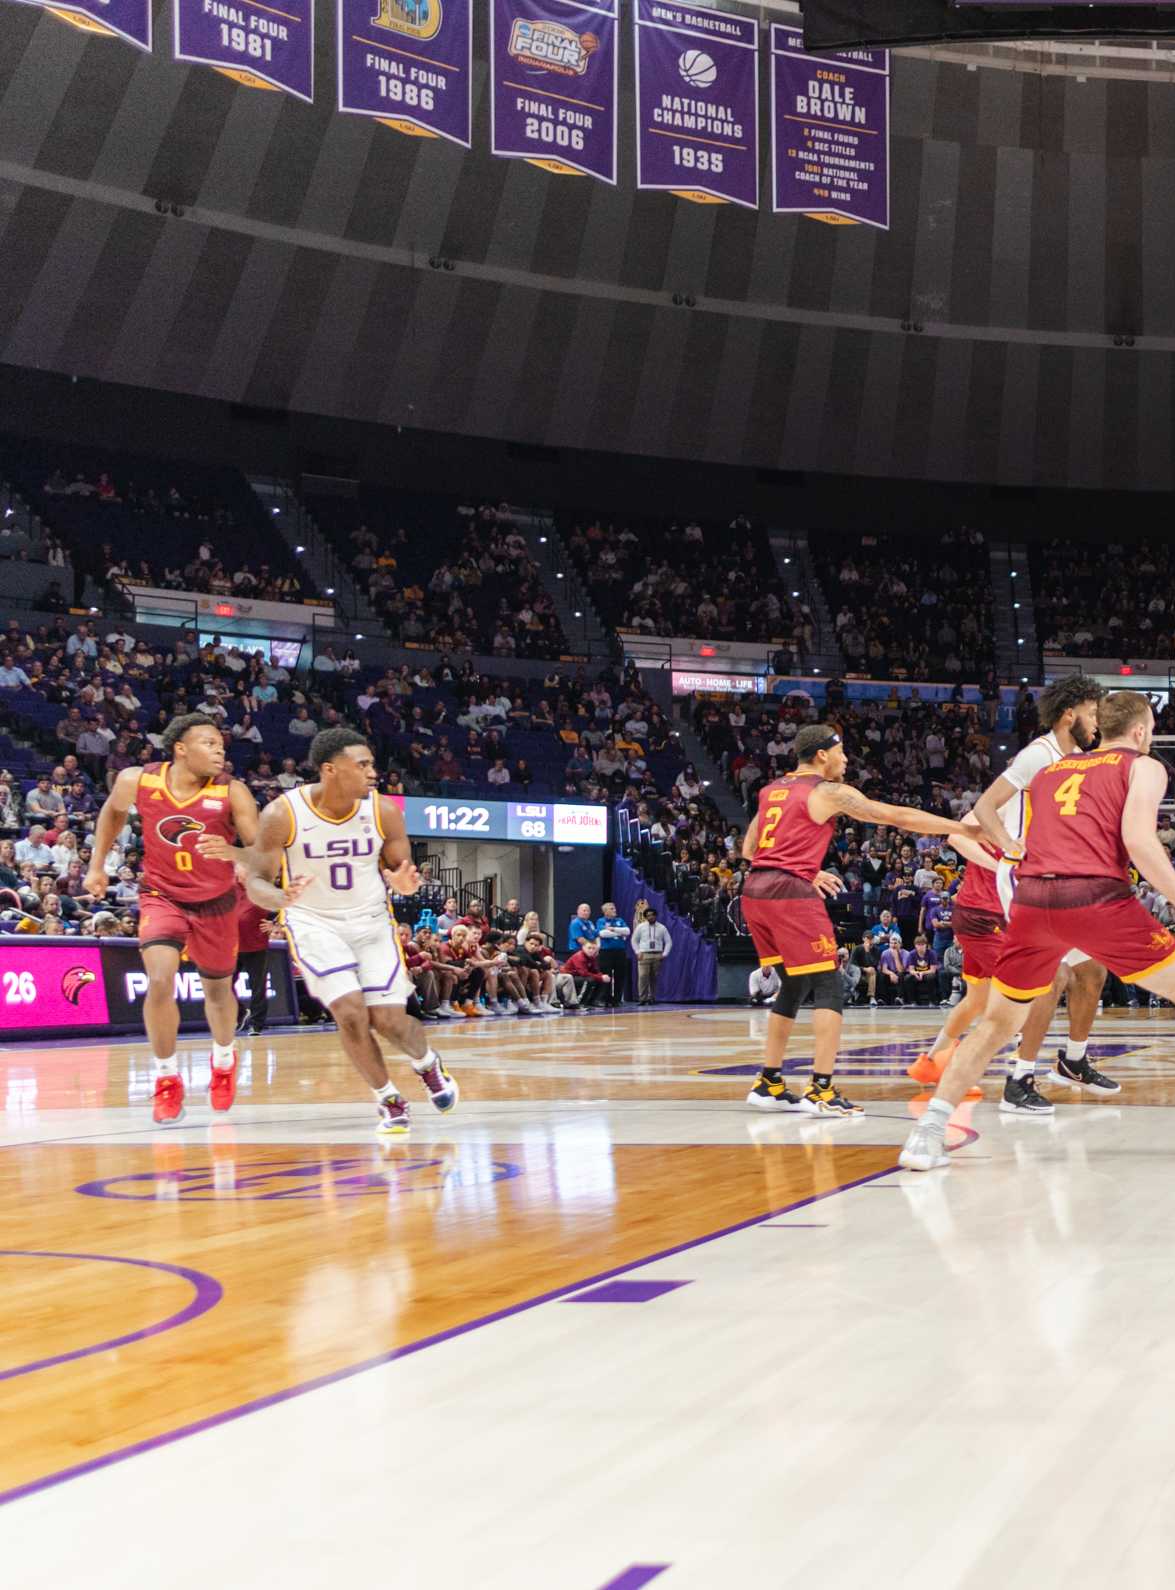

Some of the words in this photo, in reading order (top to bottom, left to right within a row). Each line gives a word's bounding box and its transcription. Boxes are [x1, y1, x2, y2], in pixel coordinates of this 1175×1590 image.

[204, 0, 246, 26] FINAL
[249, 15, 288, 41] FOUR
[652, 7, 682, 22] MEN'S
[685, 14, 742, 36] BASKETBALL
[220, 23, 272, 61] 1981
[516, 36, 580, 65] FOUR
[532, 30, 579, 52] FINAL
[366, 53, 406, 78] FINAL
[410, 67, 446, 90] FOUR
[816, 69, 846, 83] COACH
[378, 75, 435, 111] 1986
[808, 80, 854, 104] DALE
[517, 97, 555, 120] FINAL
[558, 108, 593, 129] FOUR
[662, 94, 734, 122] NATIONAL
[796, 95, 866, 124] BROWN
[526, 117, 584, 150] 2006
[653, 107, 743, 138] CHAMPIONS
[811, 129, 832, 140] FINAL
[834, 133, 858, 144] FOURS
[673, 145, 724, 173] 1935
[798, 151, 818, 162] NCAA
[820, 154, 875, 171] TOURNAMENTS
[814, 142, 829, 151] SEC
[831, 145, 855, 156] TITLES
[795, 171, 820, 183] COACH
[821, 176, 831, 185] OF
[833, 178, 847, 187] THE
[849, 181, 868, 190] YEAR
[823, 167, 858, 180] NATIONAL
[831, 190, 850, 200] WINS
[679, 676, 702, 686] AUTO
[704, 677, 731, 687] HOME
[736, 679, 753, 689] LIFE
[1054, 773, 1087, 816] 4
[424, 804, 490, 831] 11:22
[516, 805, 547, 817] LSU
[520, 820, 546, 838] 68
[759, 806, 782, 848] 2
[174, 851, 193, 872] 0
[303, 837, 374, 860] LSU
[330, 861, 353, 891] 0
[3, 971, 37, 1005] 26
